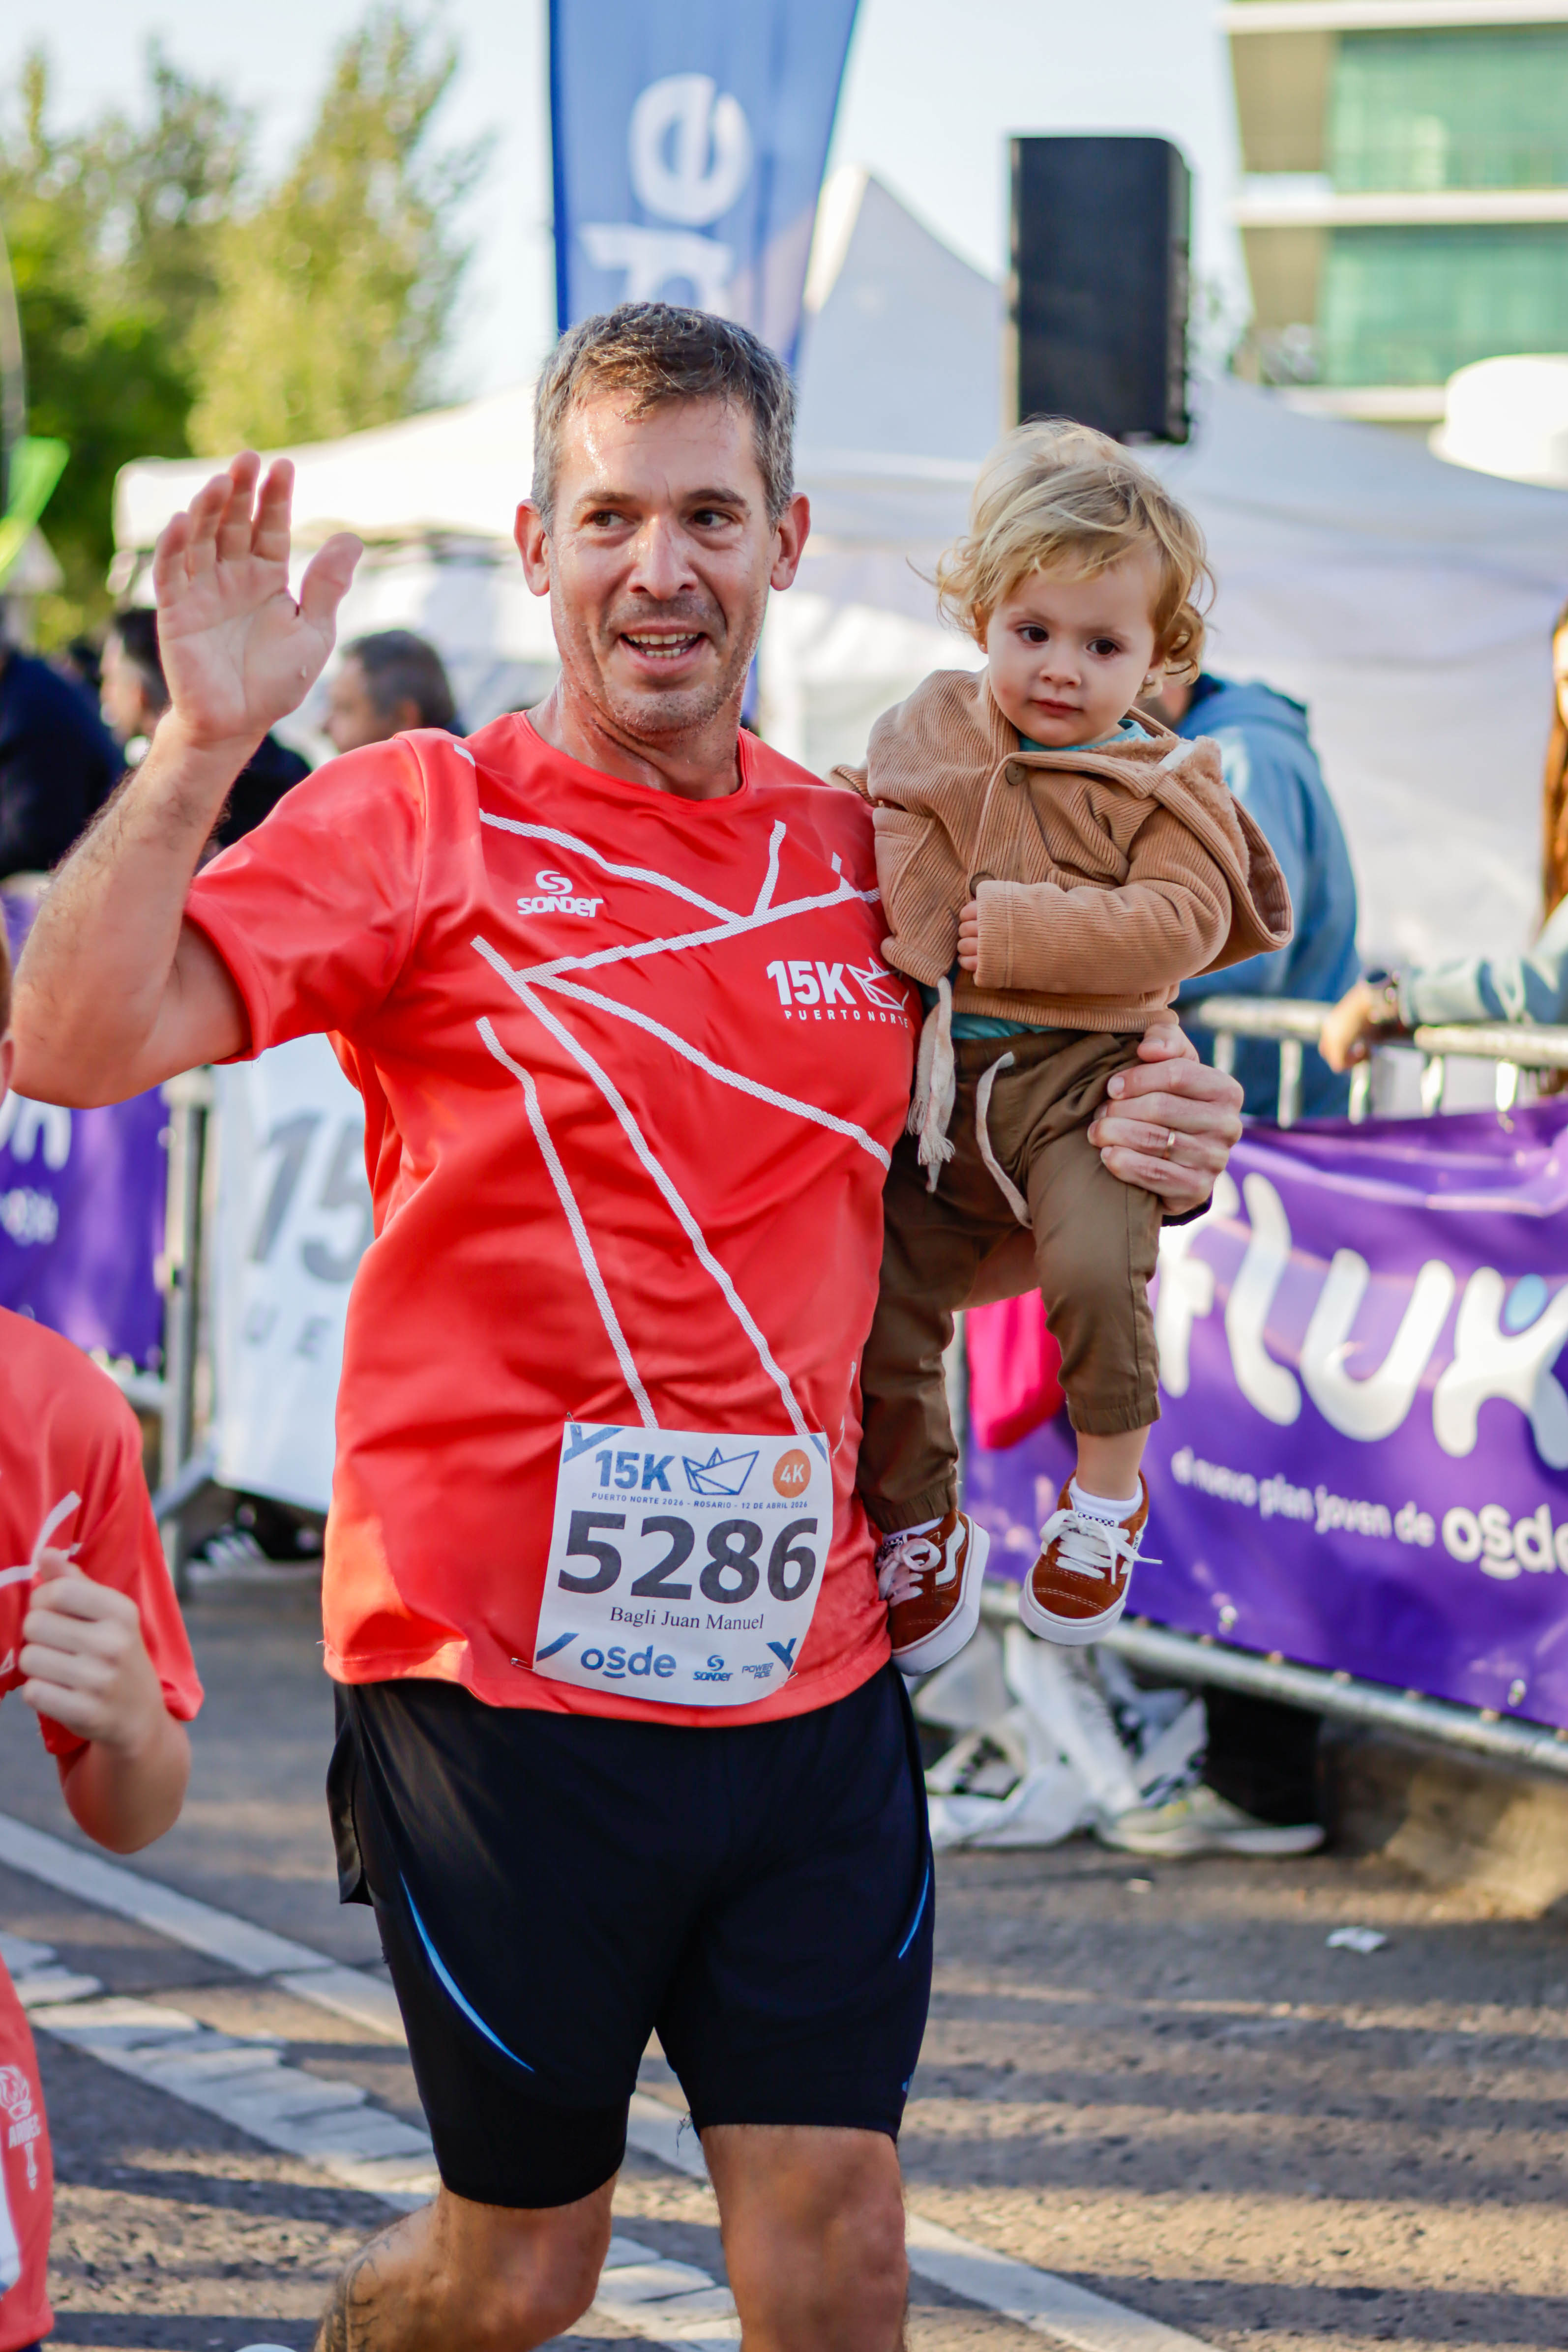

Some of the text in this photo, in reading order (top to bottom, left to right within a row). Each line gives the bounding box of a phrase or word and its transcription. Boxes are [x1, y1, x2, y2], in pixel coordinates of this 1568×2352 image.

[766, 960, 857, 1005] 15K
[784, 1009, 909, 1029] PUERTO NORTE
[595, 1449, 675, 1492] 15K
[780, 1464, 804, 1484] 4K
[591, 1492, 627, 1501] PUERTO
[629, 1496, 660, 1504] NORTE
[693, 1500, 732, 1509] ROSARIO
[1259, 1472, 1315, 1522] plan
[1394, 1500, 1436, 1548] de
[558, 1510, 818, 1604] 5286
[610, 1607, 765, 1630] Bagli Juan Manuel
[580, 1644, 677, 1678] osde
[741, 1662, 774, 1673] POWER
